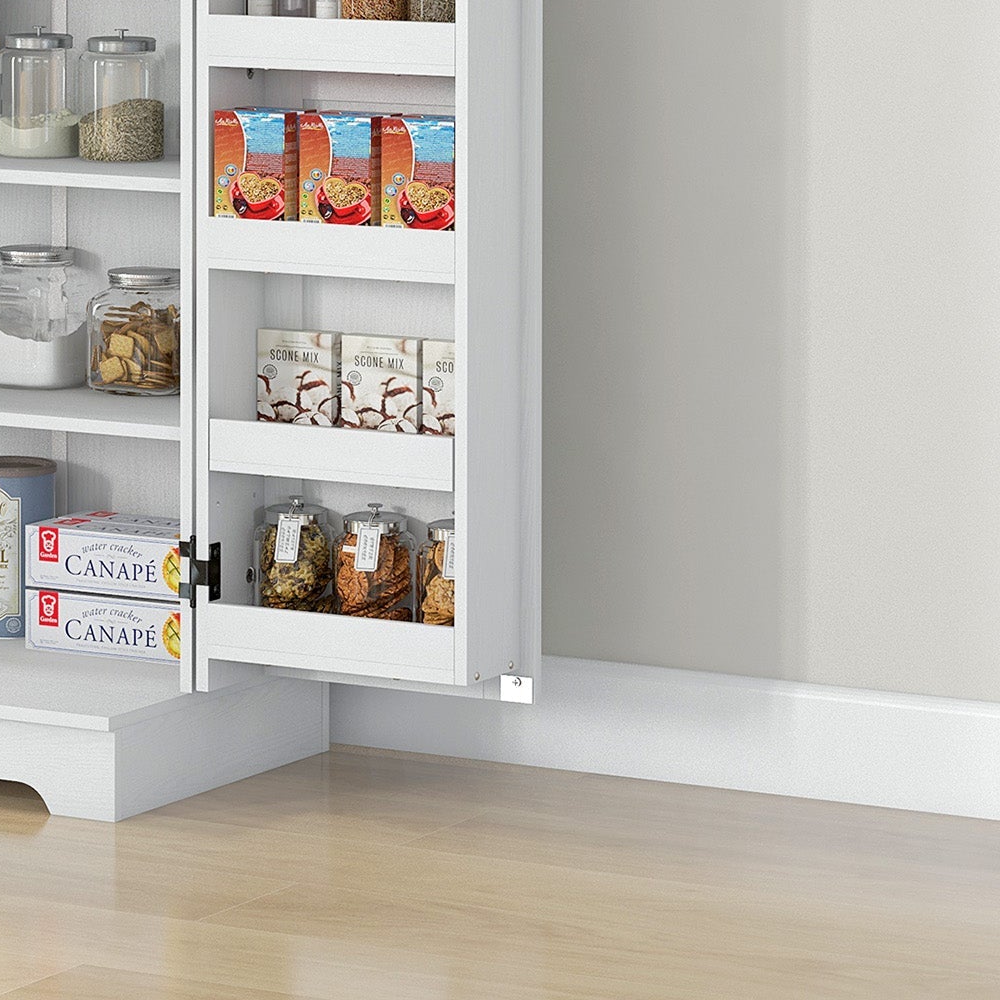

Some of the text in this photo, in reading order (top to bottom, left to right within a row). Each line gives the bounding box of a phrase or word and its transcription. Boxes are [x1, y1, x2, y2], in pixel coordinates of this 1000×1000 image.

[270, 349, 319, 363] SCONE MIX
[354, 355, 404, 370] SCONE MIX
[82, 542, 143, 559] water cracker
[65, 554, 158, 583] CANAPÉ
[40, 615, 58, 623] Garden
[82, 607, 143, 624] water cracker
[65, 618, 158, 648] CANAPÉ
